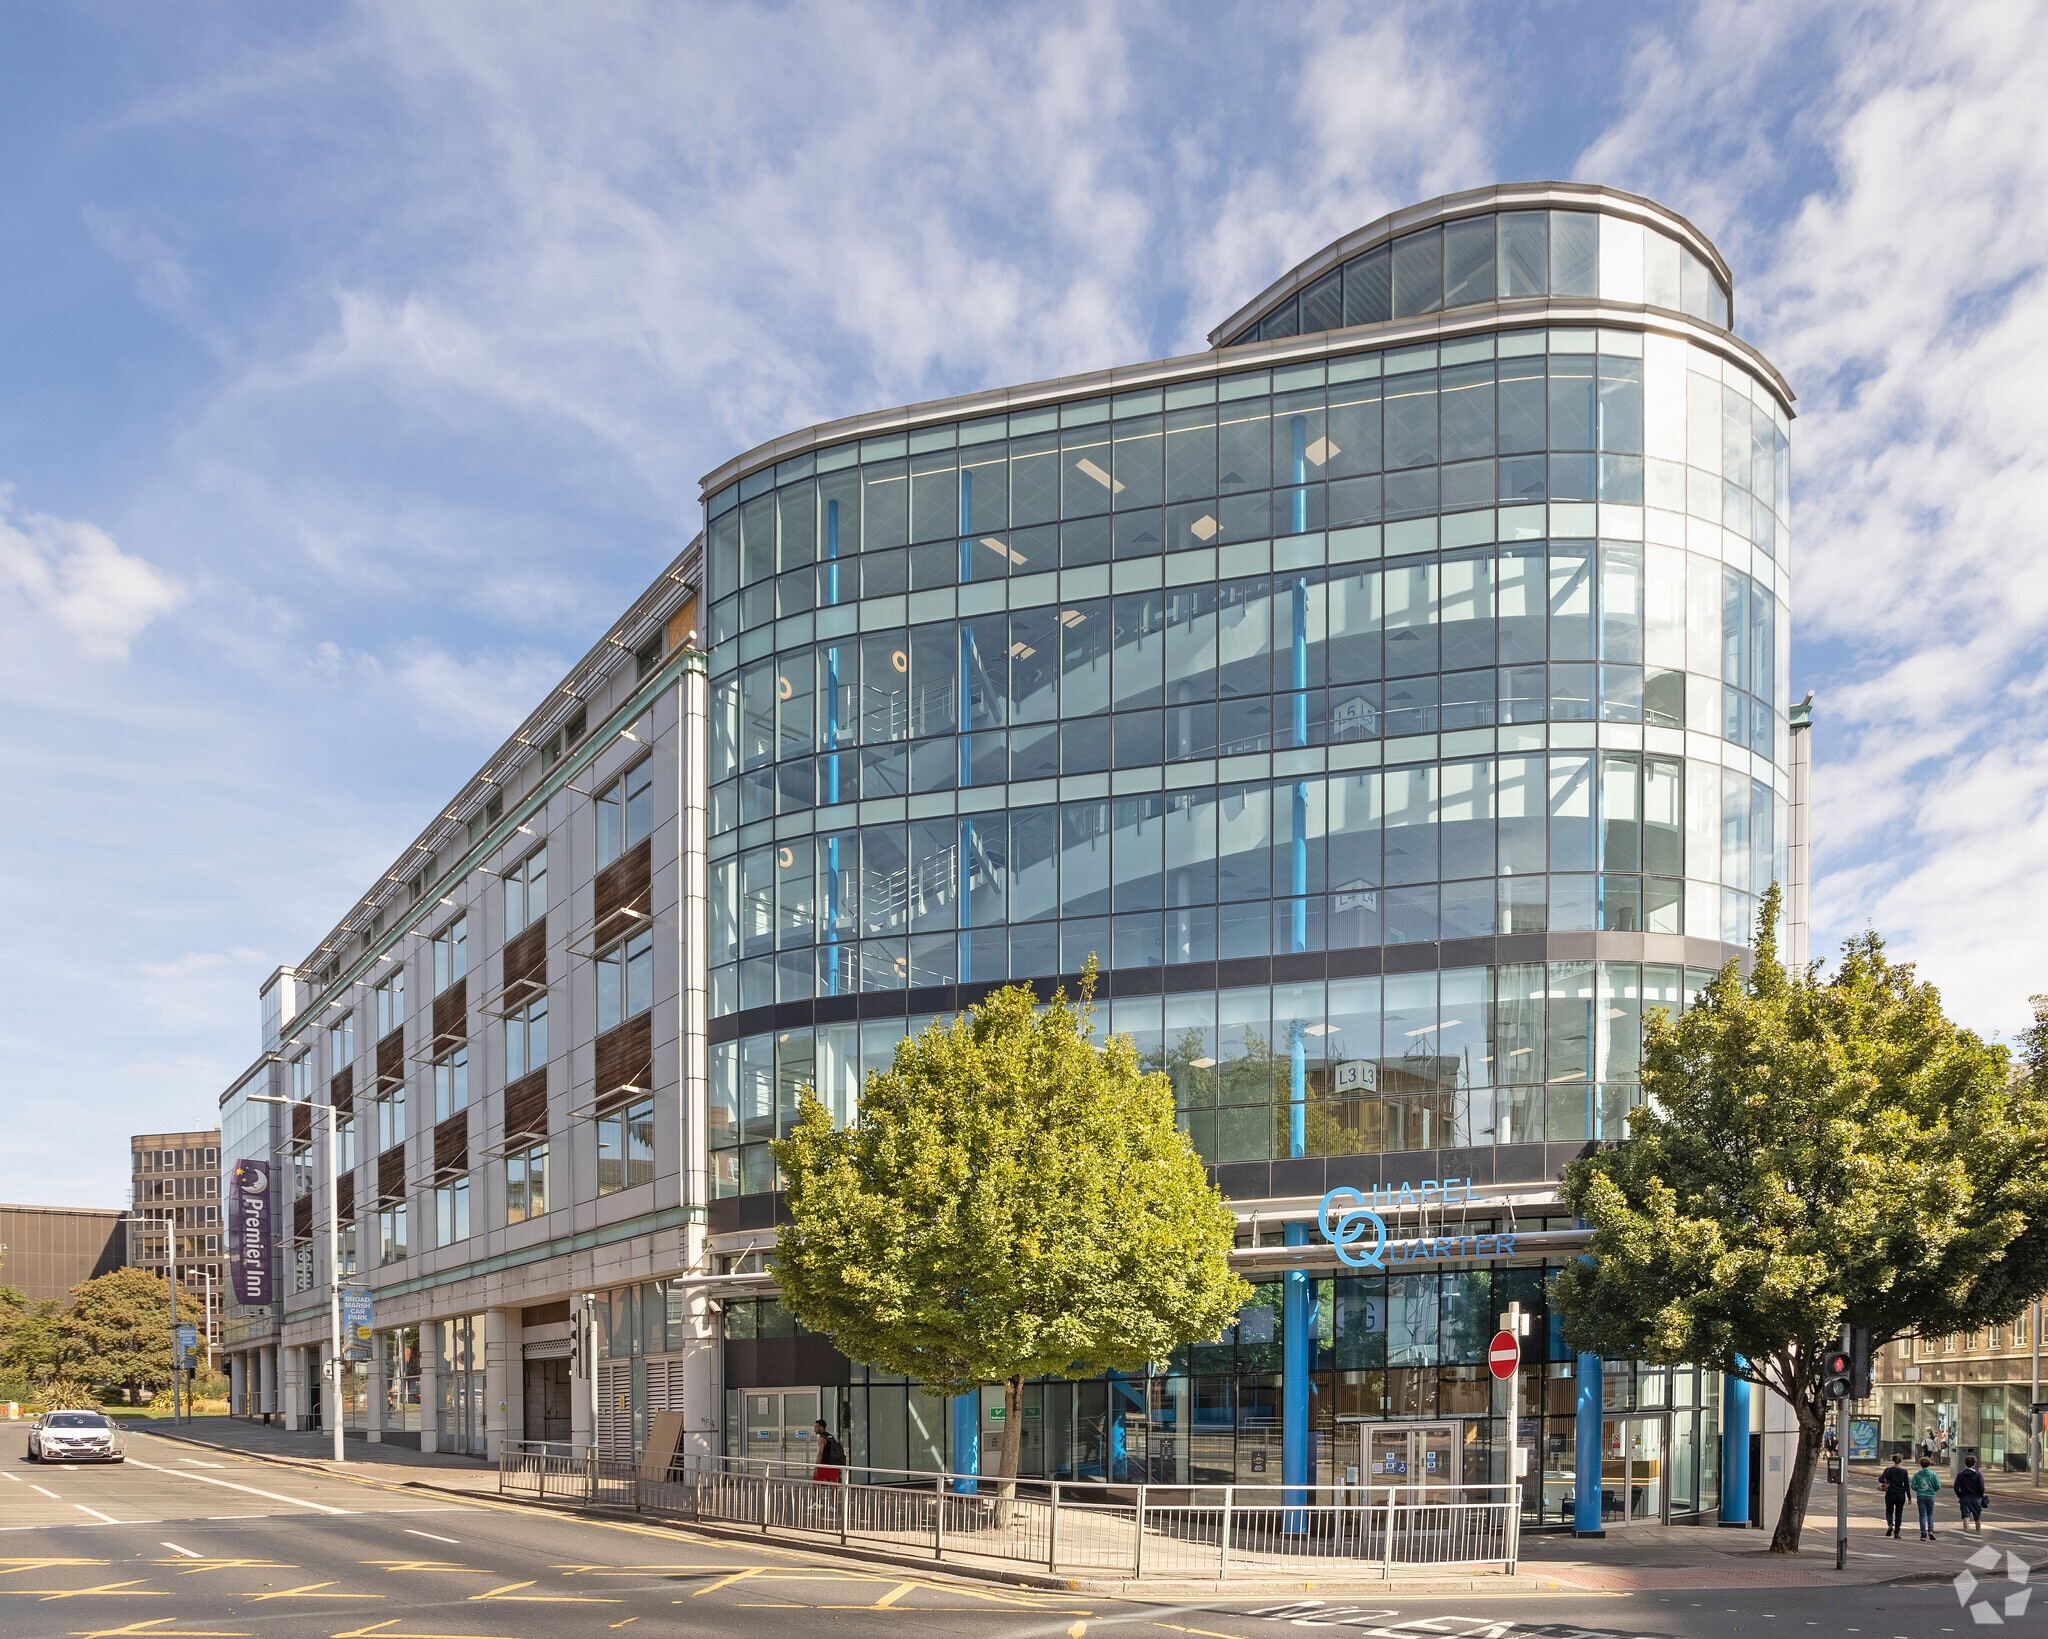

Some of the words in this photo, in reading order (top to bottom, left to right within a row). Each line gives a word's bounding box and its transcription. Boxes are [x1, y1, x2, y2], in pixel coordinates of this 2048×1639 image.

[1338, 704, 1356, 726] L5
[1340, 886, 1357, 906] L4
[1339, 1067, 1357, 1085] L3
[1362, 1066, 1374, 1084] L3
[245, 1198, 265, 1268] Premier
[246, 1270, 265, 1297] Inn
[1246, 1600, 1401, 1627] NO
